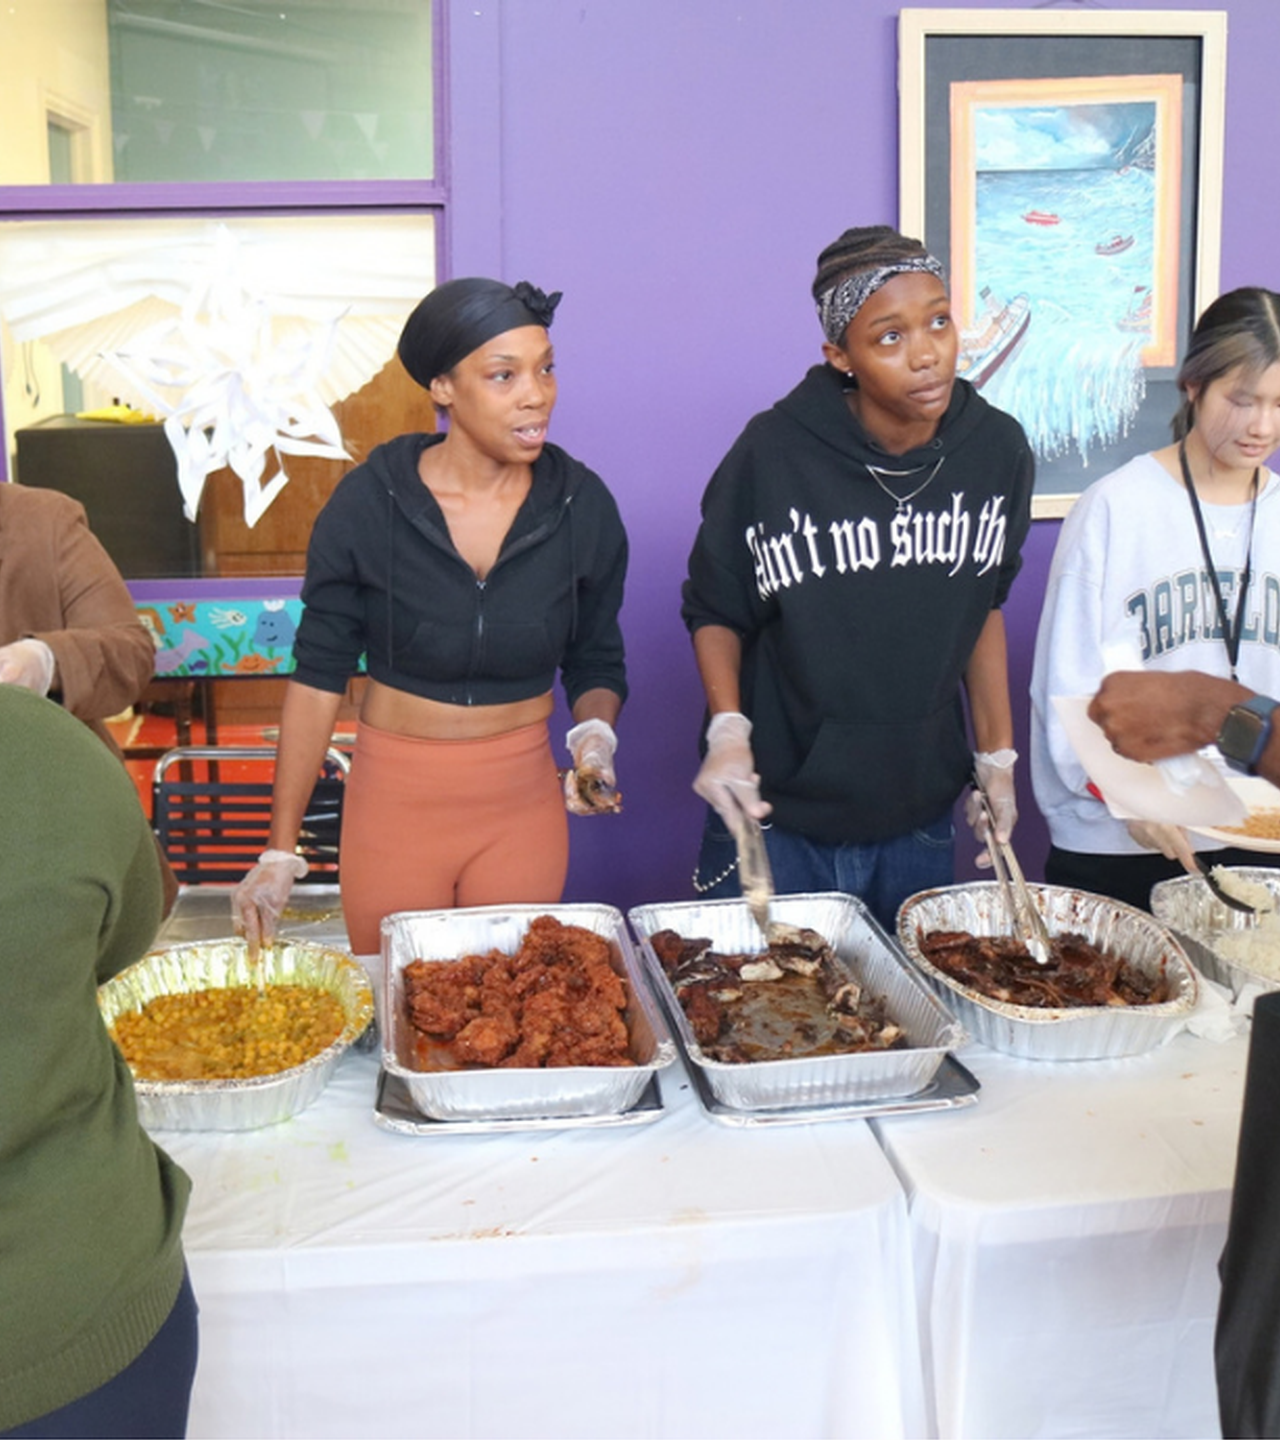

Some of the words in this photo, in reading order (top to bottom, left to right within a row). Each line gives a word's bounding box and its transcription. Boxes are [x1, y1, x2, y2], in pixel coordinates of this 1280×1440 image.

[828, 517, 880, 575] no
[890, 492, 970, 577] such
[972, 495, 1007, 577] th
